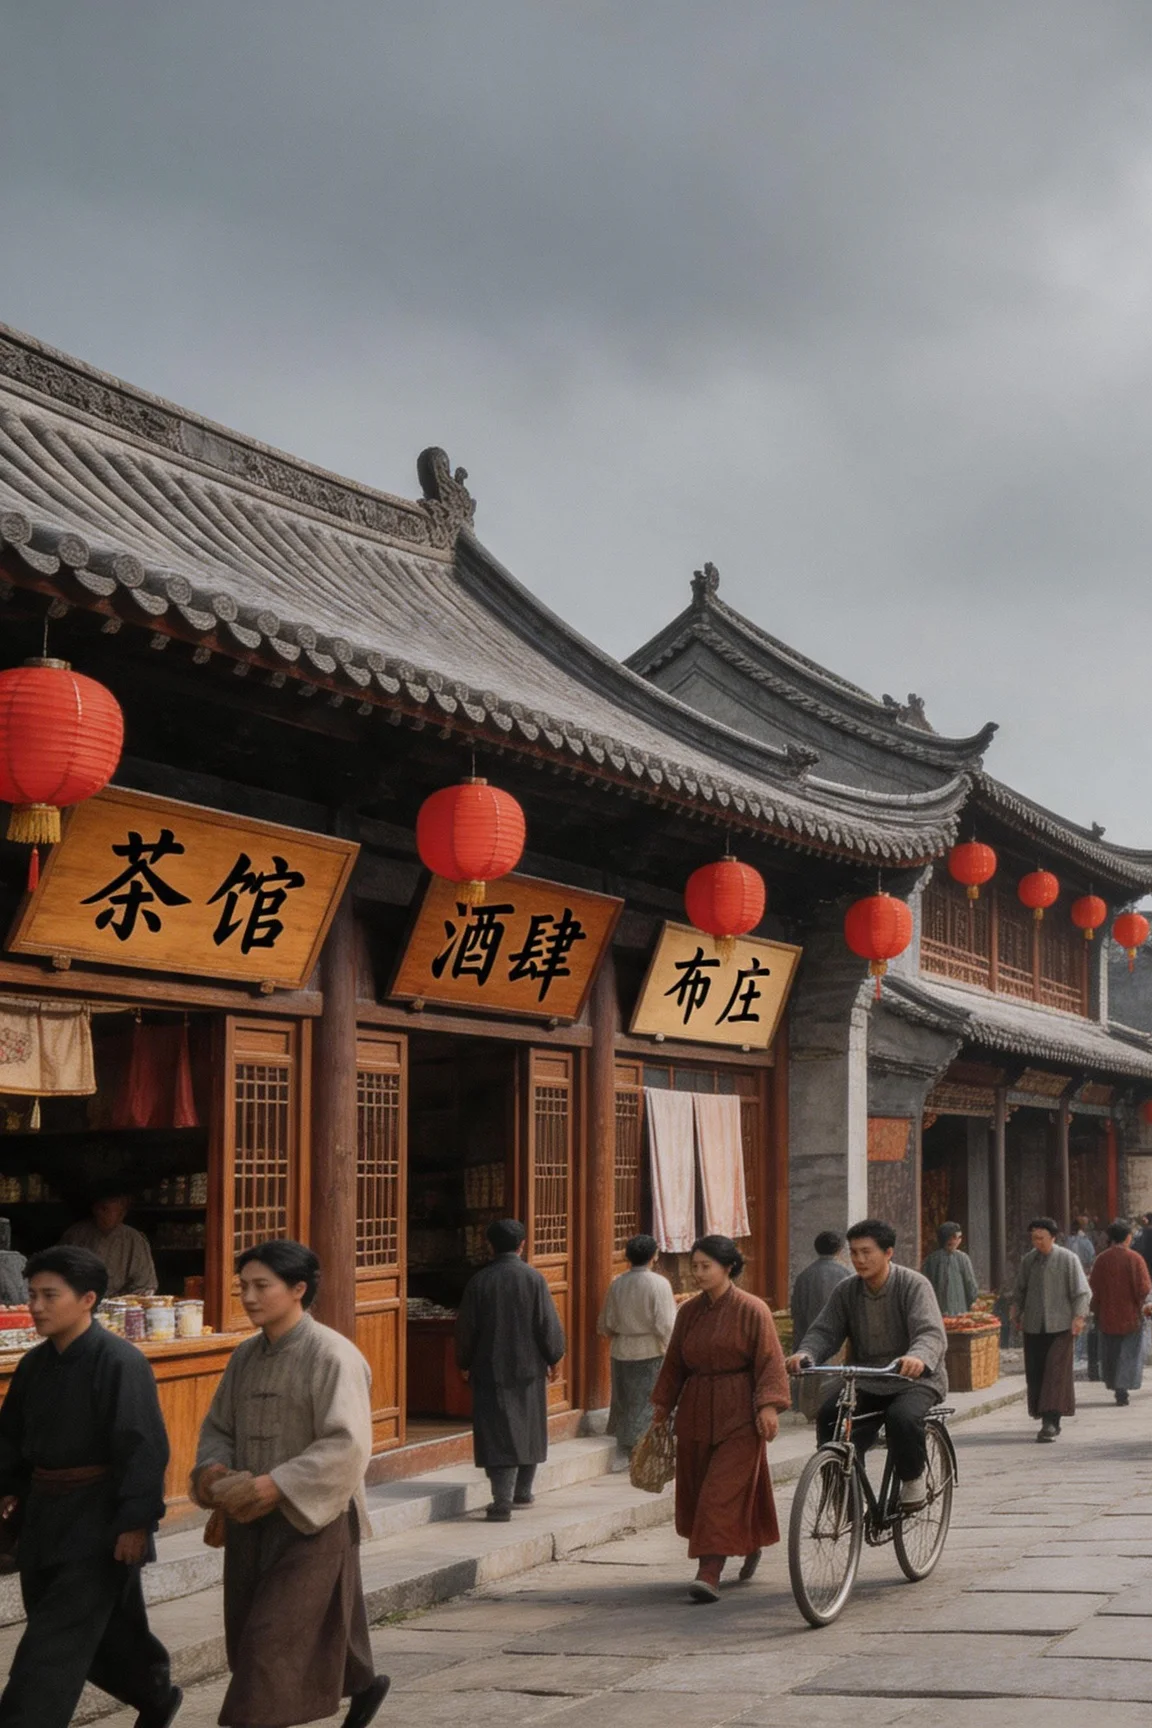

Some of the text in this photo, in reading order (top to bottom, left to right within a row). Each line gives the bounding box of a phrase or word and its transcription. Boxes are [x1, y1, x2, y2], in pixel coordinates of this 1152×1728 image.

[80, 828, 305, 955] 茶馆
[431, 902, 586, 1002] 酒肆
[664, 947, 770, 1025] 布庄
